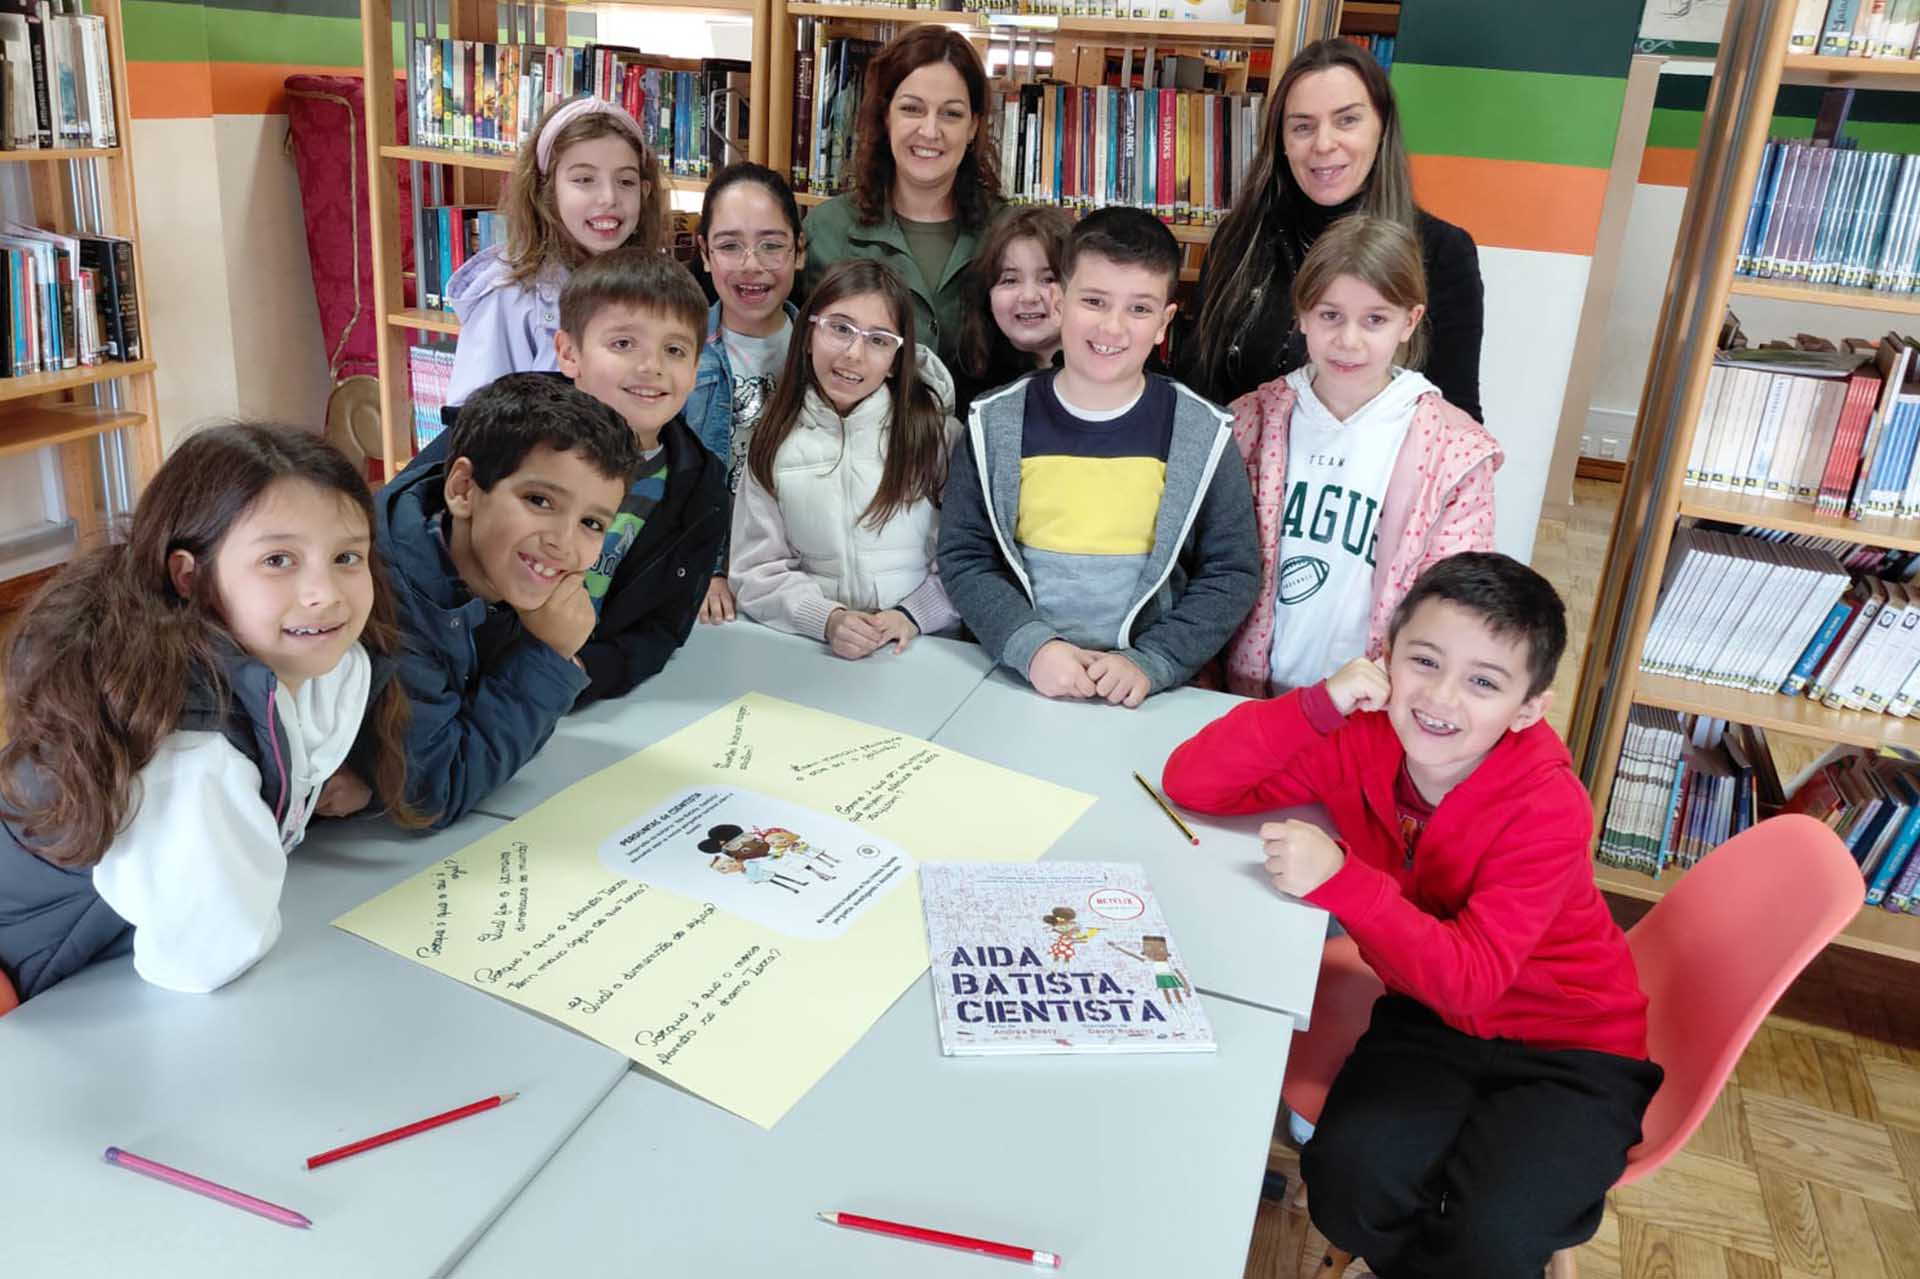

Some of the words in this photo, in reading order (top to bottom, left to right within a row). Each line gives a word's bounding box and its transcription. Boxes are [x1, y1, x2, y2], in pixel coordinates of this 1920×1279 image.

[1126, 115, 1136, 159] SPARKS
[1162, 115, 1170, 160] SPARKS
[1309, 454, 1345, 467] TEAM
[951, 946, 1043, 968] AIDA
[953, 973, 1136, 997] BATISTA,
[957, 1000, 1168, 1024] CIENTISTA
